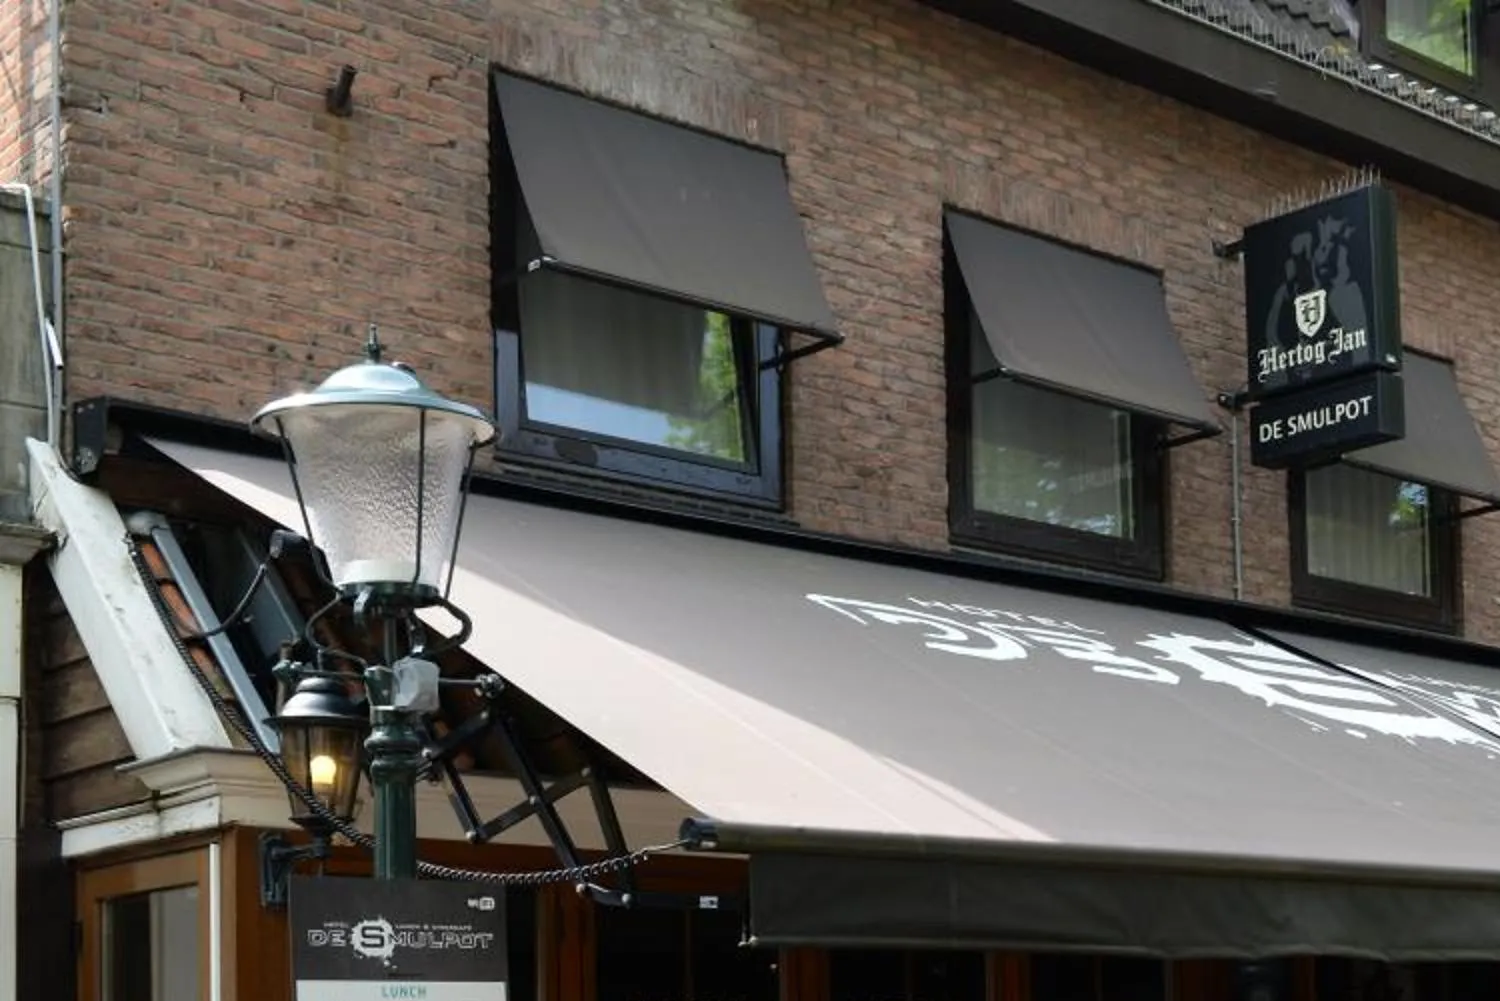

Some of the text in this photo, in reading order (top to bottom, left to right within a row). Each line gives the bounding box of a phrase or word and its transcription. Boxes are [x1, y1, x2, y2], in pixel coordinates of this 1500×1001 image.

[1258, 327, 1367, 382] Hertog Jan
[1260, 395, 1373, 442] DE SMULPOT
[307, 929, 347, 947] DE
[381, 985, 427, 998] LUNCH
